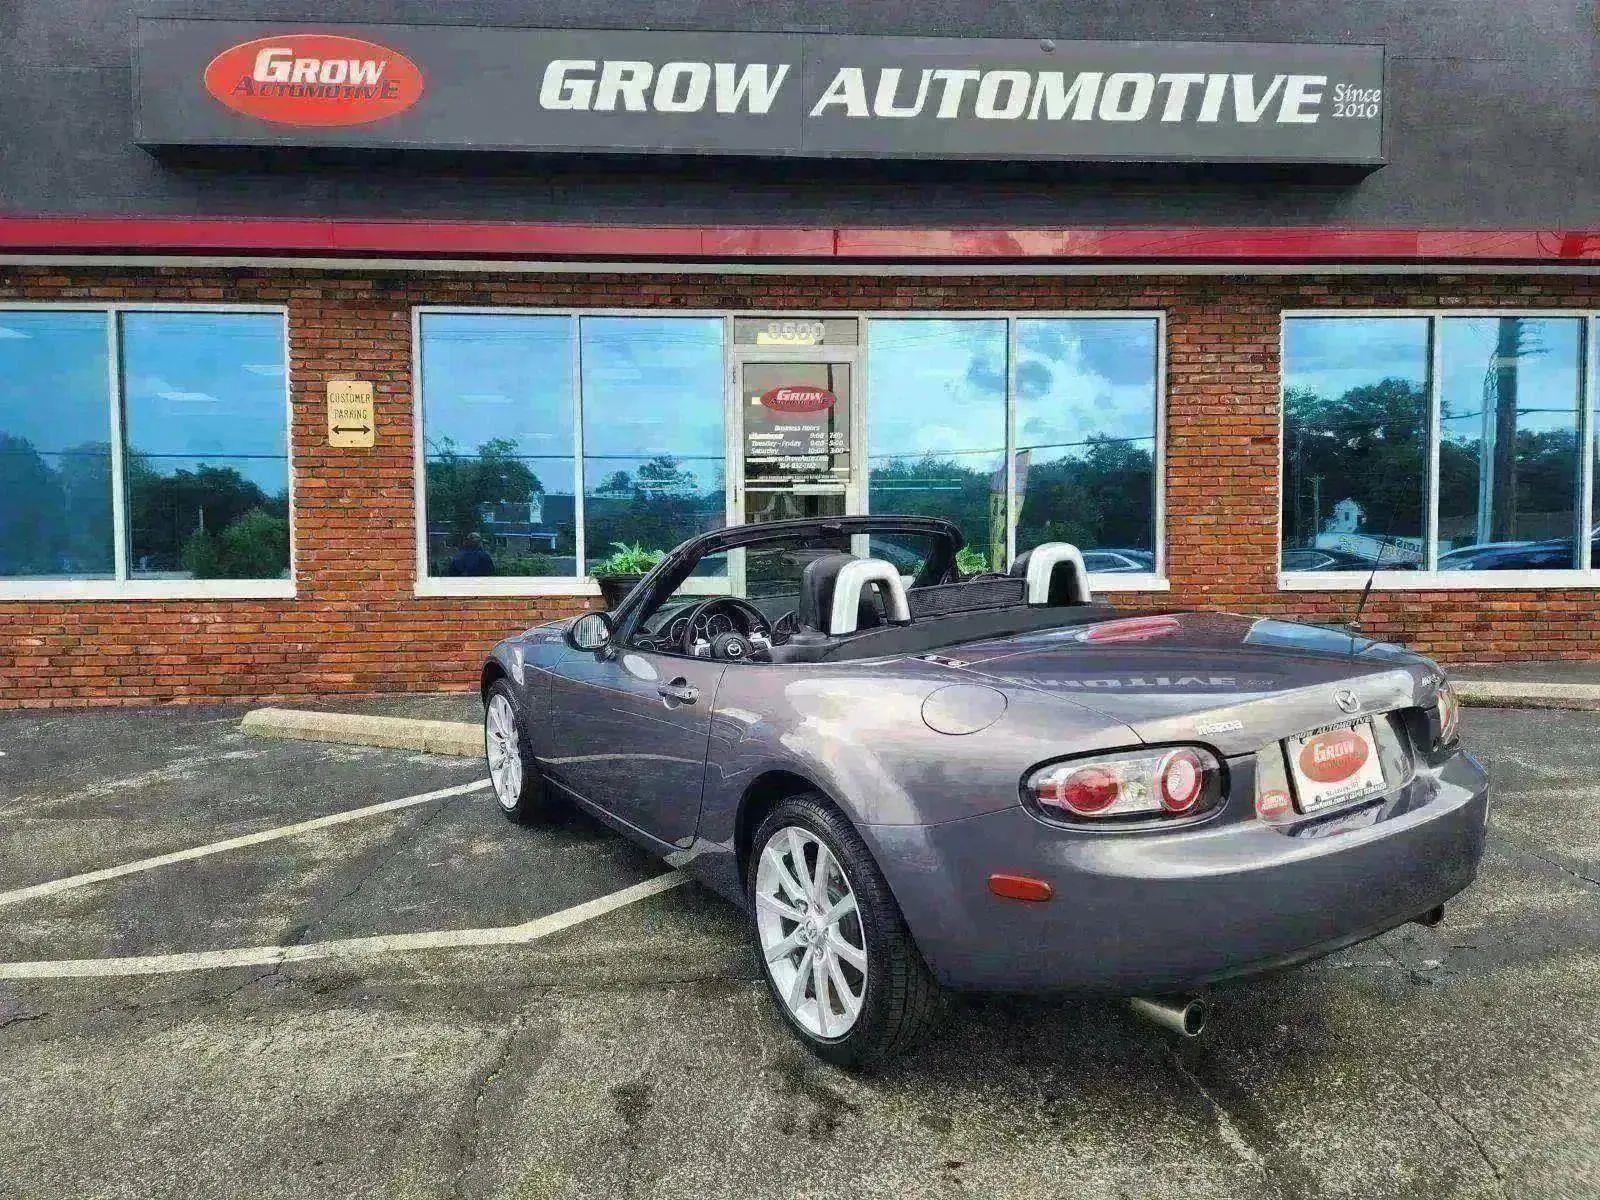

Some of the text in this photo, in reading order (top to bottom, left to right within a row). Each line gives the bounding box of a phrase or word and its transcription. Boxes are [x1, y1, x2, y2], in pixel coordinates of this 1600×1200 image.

[253, 48, 388, 84] GROW
[231, 75, 400, 99] AUTOMOTIVE
[539, 59, 1327, 123] GROW AUTOMOTIVE
[1333, 83, 1381, 102] Since
[1332, 103, 1378, 118] 2010
[329, 392, 371, 403] CUSTOMER
[335, 409, 367, 420] PARKING
